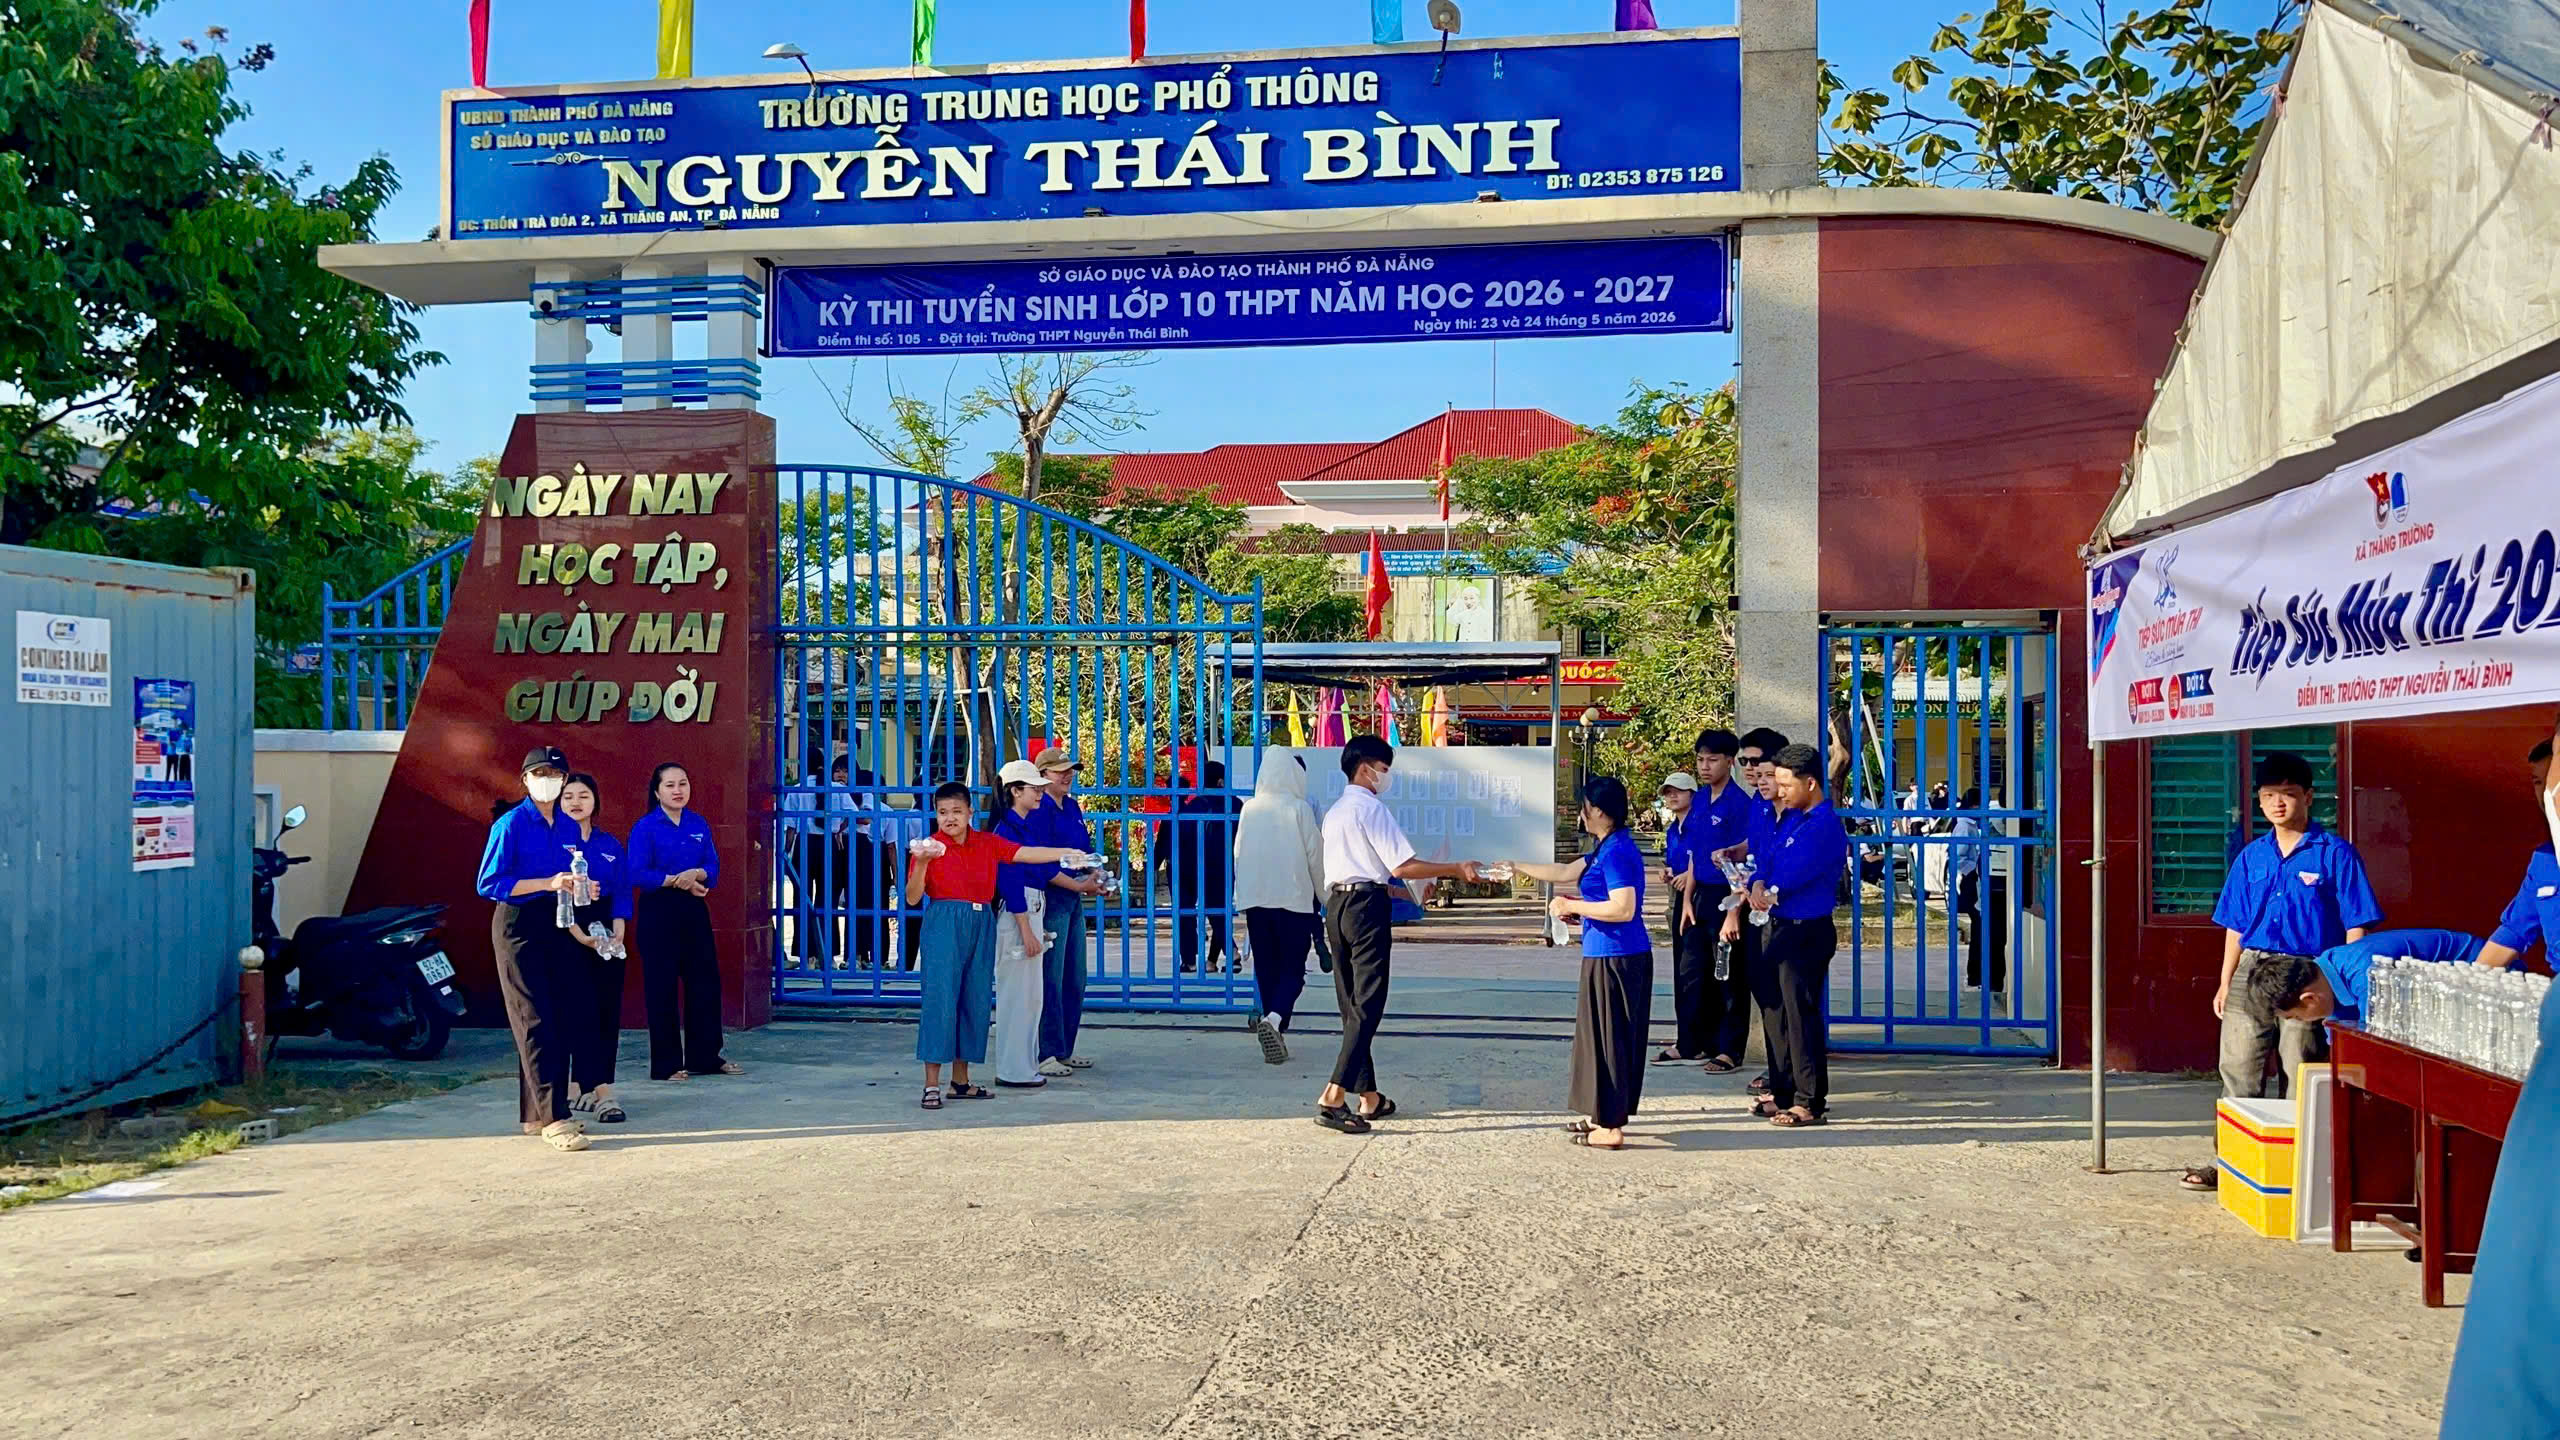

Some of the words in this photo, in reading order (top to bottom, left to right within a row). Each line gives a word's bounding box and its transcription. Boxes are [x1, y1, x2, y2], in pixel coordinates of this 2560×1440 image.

[460, 111, 505, 125] UBND
[510, 105, 561, 123] THÀNH
[566, 101, 599, 120] PHỐ
[603, 102, 624, 118] ĐÀ
[759, 89, 908, 129] TRƯỜNG
[921, 87, 1049, 122] TRUNG
[1062, 82, 1140, 121] HỌC
[1154, 64, 1232, 112] PHỔ
[1245, 67, 1379, 107] THÔNG
[470, 131, 492, 150] SỞ
[497, 130, 533, 149] GIÁO
[537, 131, 569, 149] DỤC
[575, 128, 594, 145] VÀ
[600, 126, 632, 143] ĐÀO
[636, 127, 667, 144] TẠO
[602, 124, 993, 209] NGUYỄN
[1023, 119, 1270, 192] THÁI
[1303, 110, 1561, 181] BÌNH
[1547, 174, 1573, 190] ĐT:
[1579, 169, 1641, 188] 02353
[1646, 167, 1683, 184] 875
[1688, 165, 1723, 182] 126
[523, 214, 547, 229] TRÀ
[581, 214, 595, 227] 2,
[600, 209, 618, 225] XÃ
[669, 210, 692, 223] AN,
[719, 206, 737, 221] ĐÀ
[1039, 266, 1061, 283] SỞ
[1065, 267, 1108, 282] GIÁO
[1111, 268, 1146, 284] DỤC
[1151, 263, 1173, 279] VÀ
[1178, 262, 1215, 279] ĐÀO
[1218, 264, 1252, 280] TẠO
[1256, 260, 1311, 276] THÀNH
[1316, 256, 1351, 275] PHỐ
[1356, 256, 1380, 273] ĐÀ
[1385, 253, 1435, 272] NẴNG
[819, 293, 859, 327] KỲ
[867, 299, 913, 326] THI
[923, 283, 1016, 325] TUYỂN
[1025, 295, 1097, 322] SINH
[1109, 285, 1169, 320] LỚP
[1180, 291, 1216, 318] 10
[1225, 288, 1301, 316] THPT
[1311, 280, 1386, 314] NĂM
[1397, 282, 1474, 318] HỌC
[1485, 279, 1565, 308] 2026
[1594, 275, 1674, 304] 2027
[1414, 318, 1451, 334] Ngày
[1455, 318, 1477, 330] thi:
[1481, 317, 1498, 329] 23
[1502, 315, 1520, 328] và
[1524, 316, 1542, 327] 24
[1545, 313, 1587, 328] tháng
[1591, 314, 1600, 326] 5
[1604, 313, 1636, 325] năm
[1641, 311, 1676, 323] 2026
[817, 331, 851, 347] Điểm
[855, 332, 871, 345] thi
[875, 331, 893, 346] số:
[898, 333, 921, 345] 105
[939, 332, 964, 347] Đặt
[967, 331, 988, 346] tại:
[991, 330, 1036, 345] Trường
[1039, 330, 1070, 342] THPT
[1073, 326, 1125, 344] Nguyễn
[1128, 327, 1156, 339] Thái
[1160, 326, 1189, 339] Bình
[490, 462, 624, 518] NGÀY
[628, 472, 730, 516] NAY
[517, 543, 622, 597] HỌC
[632, 531, 729, 594] TẬP,
[493, 600, 627, 654] NGÀY
[628, 612, 725, 654] MAI
[2230, 585, 2287, 692] Tiếp
[2285, 587, 2338, 669] Sức
[2412, 543, 2487, 647] Thi
[504, 669, 621, 723] GIÚP
[628, 663, 718, 723] ĐỜI
[2186, 672, 2199, 696] ĐỢT
[2199, 673, 2204, 691] 2
[2320, 683, 2335, 705] THI:
[2337, 675, 2377, 703] TRƯỜNG
[2378, 675, 2404, 699] THPT
[2404, 660, 2451, 697] NGUYỄN
[2452, 660, 2481, 691] THÁI
[2481, 657, 2513, 689] BÌNH
